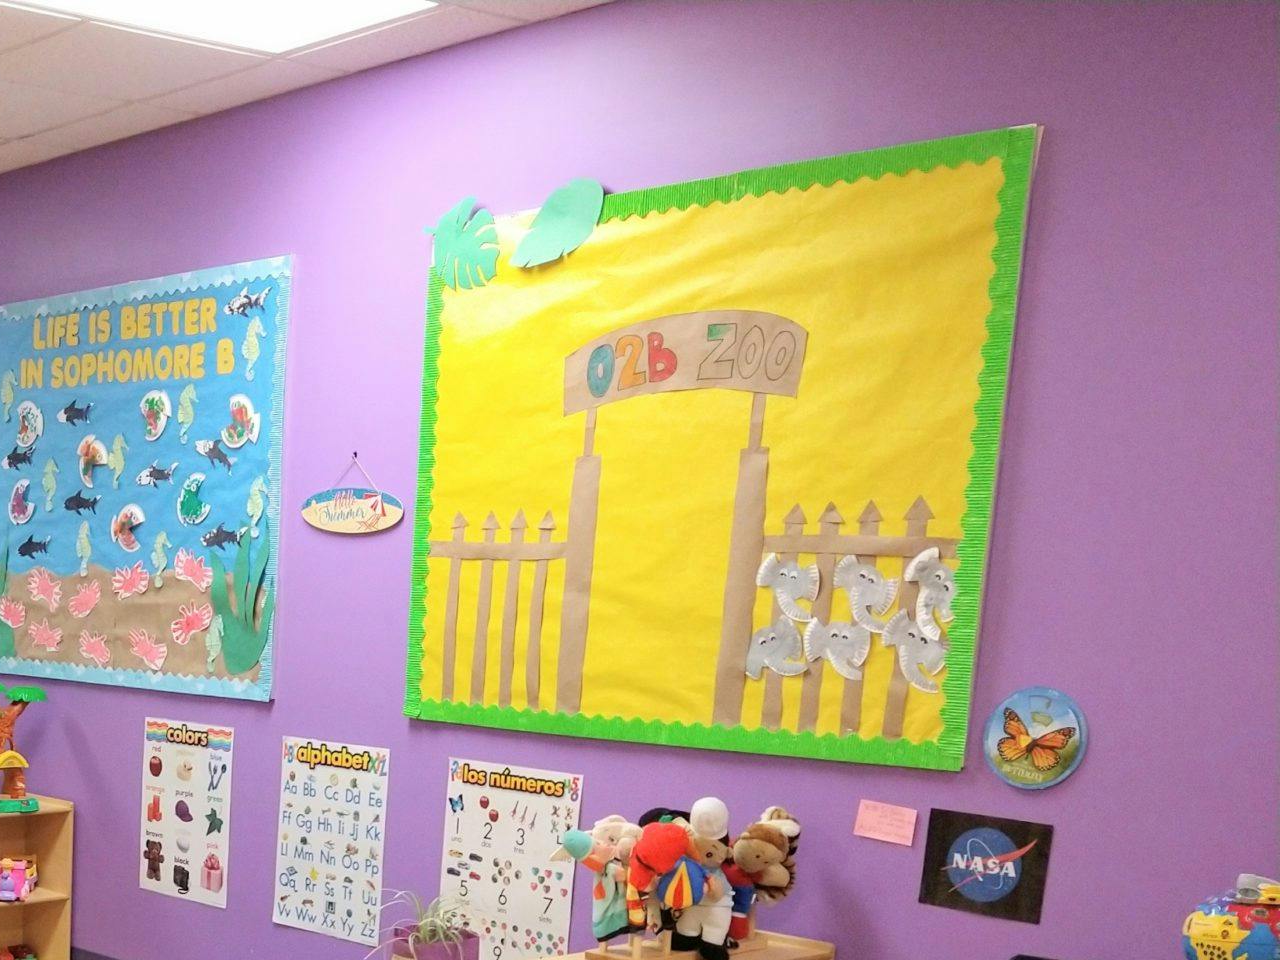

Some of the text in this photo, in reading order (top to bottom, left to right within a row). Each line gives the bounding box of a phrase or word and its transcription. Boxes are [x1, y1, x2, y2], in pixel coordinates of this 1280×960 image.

[32, 297, 218, 350] LIFE IS BETTER
[20, 338, 235, 389] IN SOPHOMORE B
[696, 323, 797, 382] ZOO
[166, 724, 209, 747] colors
[297, 741, 371, 771] alphabet
[284, 780, 383, 808] Aa Bb Cc Dd Ee
[462, 763, 565, 798] los números
[282, 810, 380, 841] Ff Gg Hh Ii Jj Kk
[456, 817, 525, 846] 1 2 3
[173, 856, 190, 865] black
[293, 845, 314, 862] Mm
[320, 849, 336, 866] Nn
[342, 854, 360, 871] Oo
[365, 859, 380, 878] Pp
[951, 852, 1017, 878] NASA
[279, 872, 378, 907] Qq Rr Ss Tt Uu
[459, 880, 553, 914] 5 6 7
[277, 901, 376, 939] Vv Ww Xx Yy Zz
